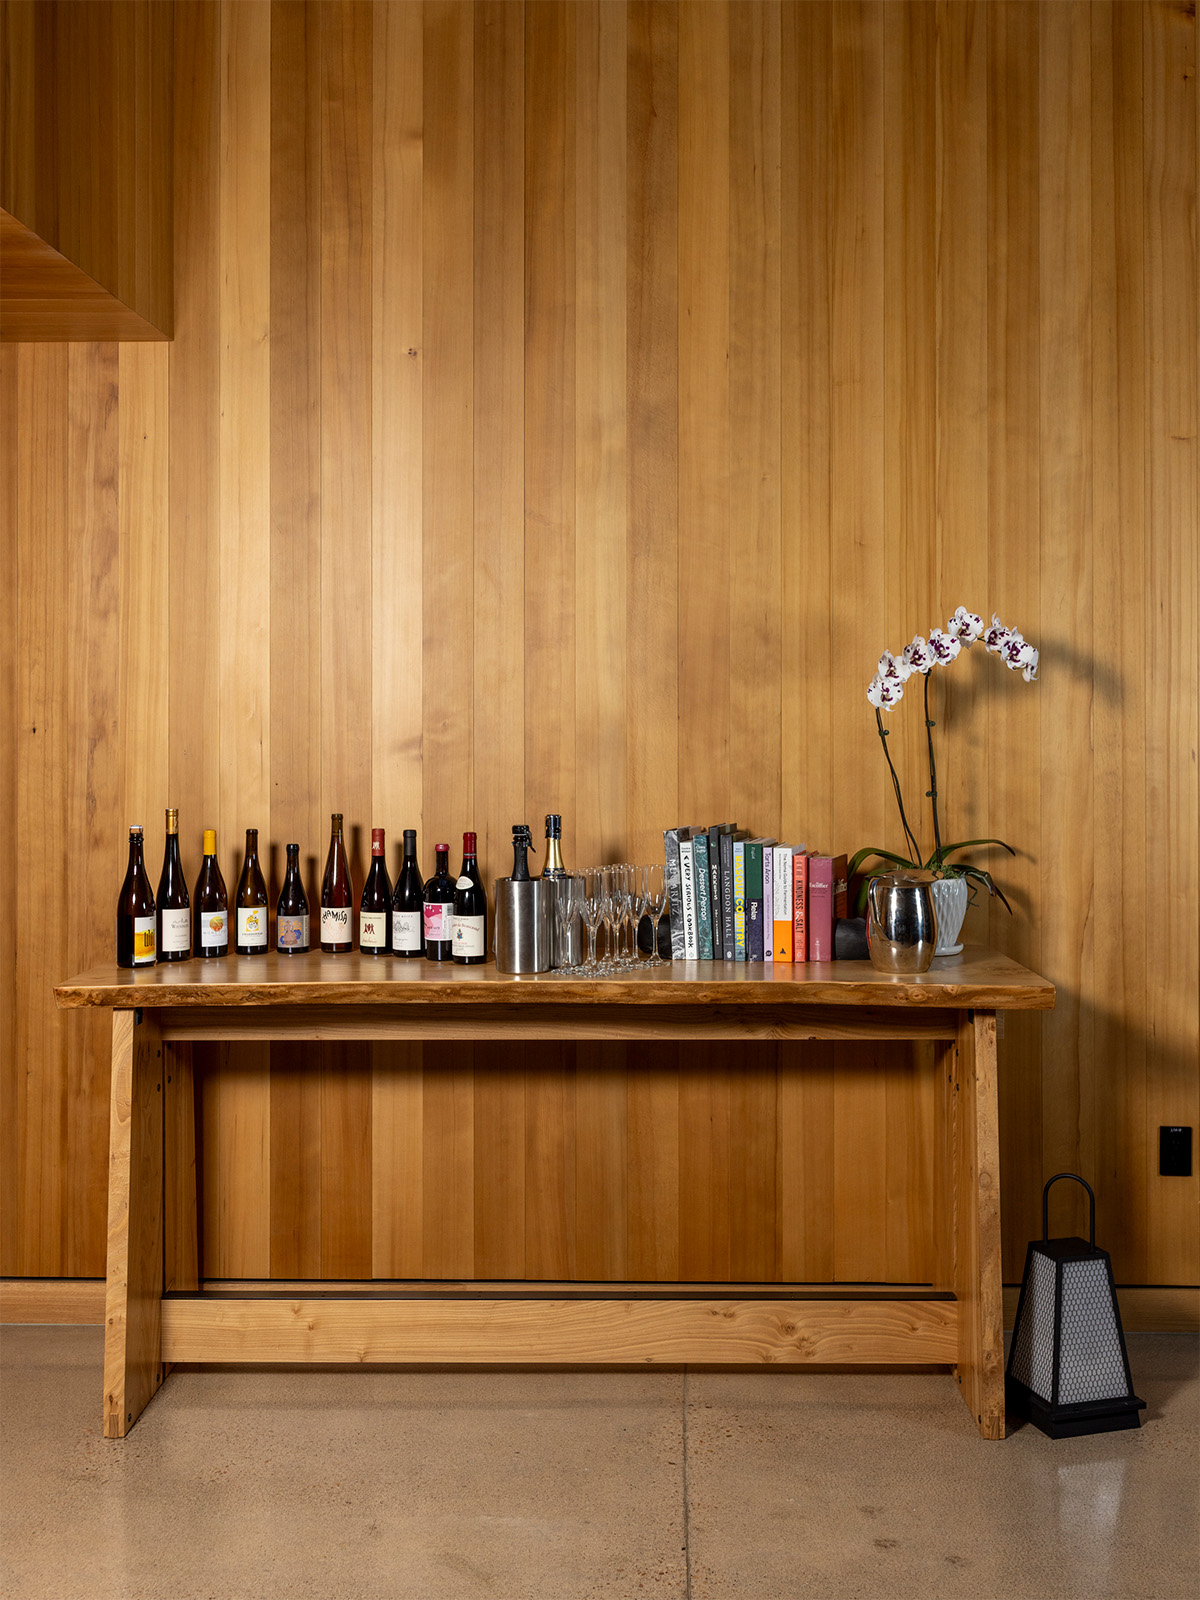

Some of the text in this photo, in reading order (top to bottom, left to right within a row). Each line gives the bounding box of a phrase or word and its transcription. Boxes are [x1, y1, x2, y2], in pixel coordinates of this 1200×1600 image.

[735, 855, 744, 897] BASQUE
[764, 852, 772, 868] Tarts
[724, 870, 732, 913] LANGDON
[764, 868, 772, 885] Anon
[685, 883, 693, 911] SERIOUS
[698, 868, 708, 921] Dessert Person
[795, 880, 804, 909] KINDNESS
[686, 913, 694, 949] COOKBOOK
[735, 898, 745, 948] COUNTRY
[795, 918, 804, 934] SALT
